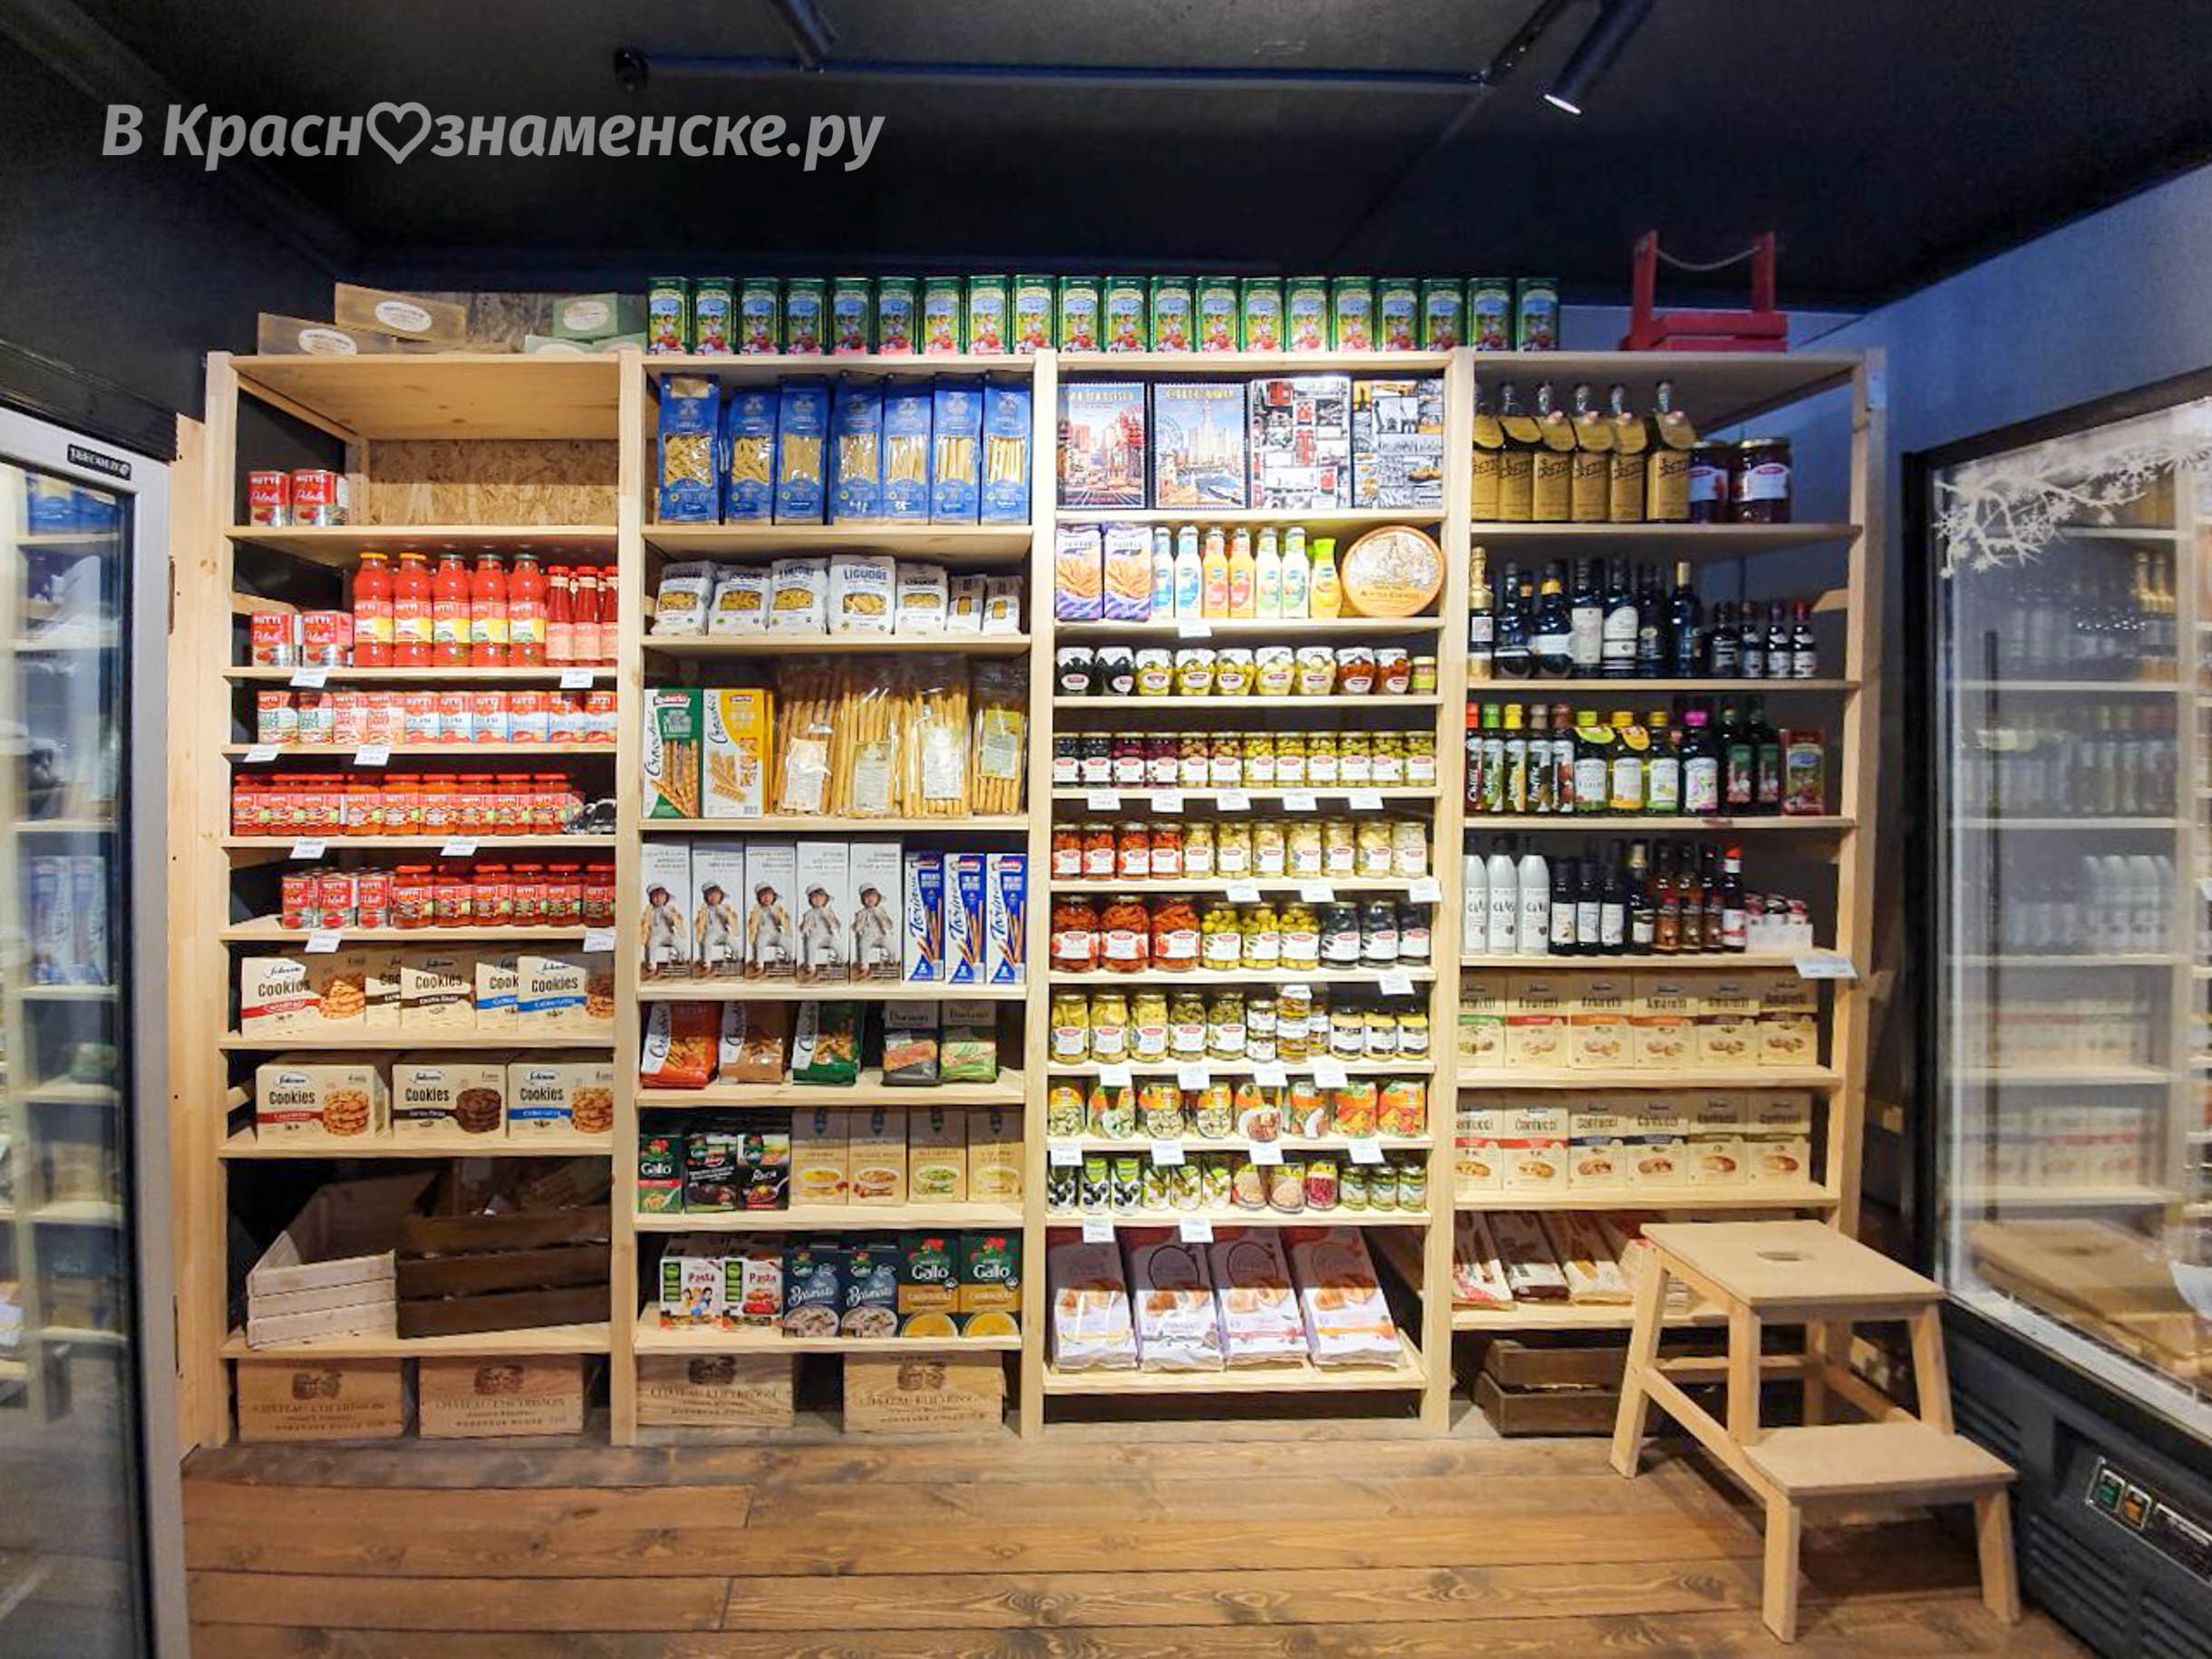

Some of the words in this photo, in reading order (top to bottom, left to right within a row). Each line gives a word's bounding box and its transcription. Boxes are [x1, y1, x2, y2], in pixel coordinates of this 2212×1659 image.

[844, 568, 888, 582] LIGUORI
[257, 979, 311, 998] Cookies
[414, 974, 463, 991] Cookies
[489, 975, 519, 991] Cook
[530, 975, 578, 994] Cookies
[268, 1091, 315, 1105] Cookies
[404, 1087, 451, 1103] Cookies
[519, 1086, 565, 1102] Cookies
[688, 1272, 715, 1284] Pasta
[750, 1272, 778, 1284] Pasta
